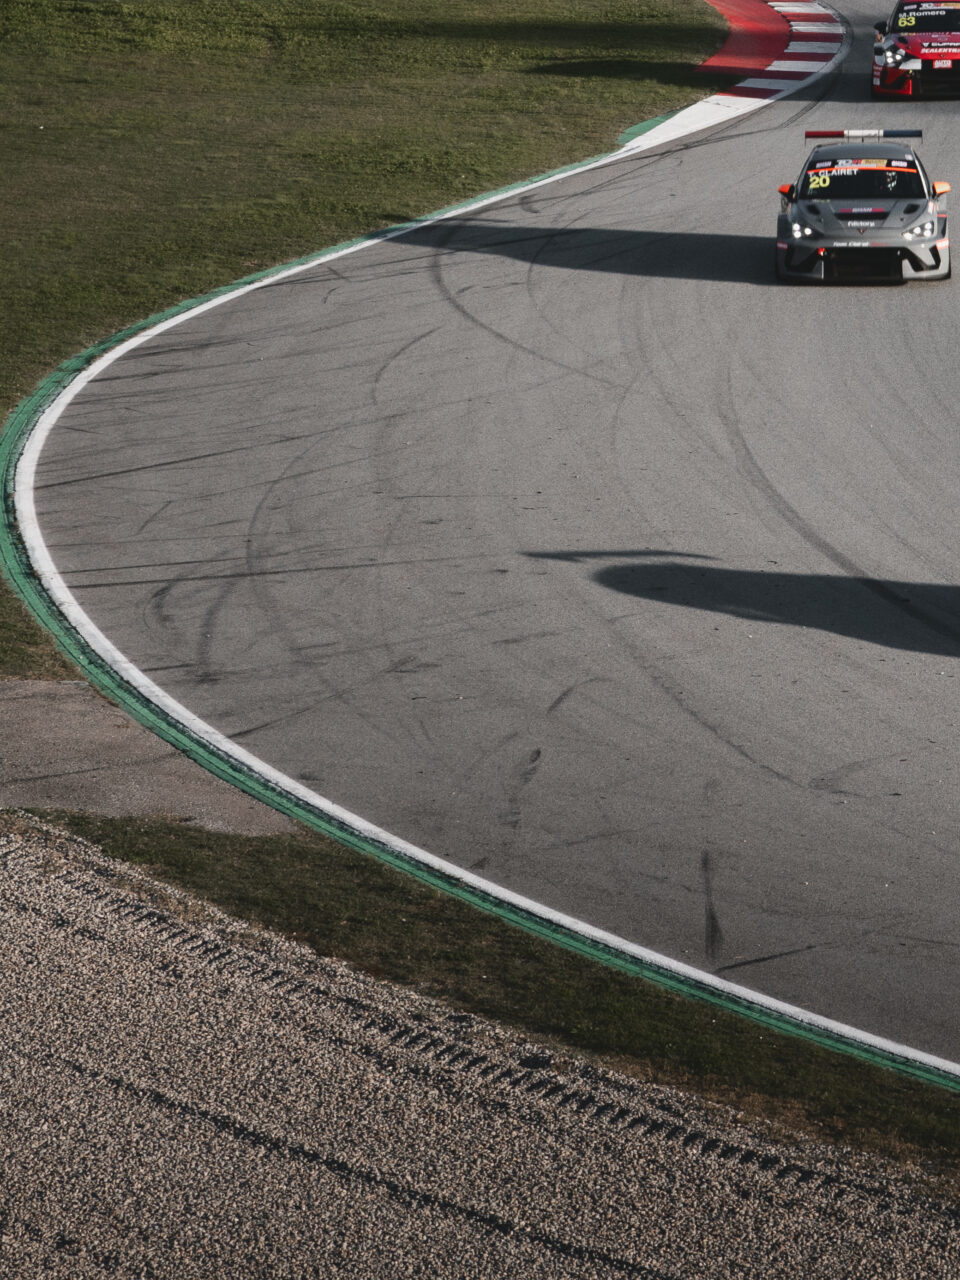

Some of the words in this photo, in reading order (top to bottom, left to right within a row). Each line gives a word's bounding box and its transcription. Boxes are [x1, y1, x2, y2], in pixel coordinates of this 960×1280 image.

[898, 18, 916, 27] 63
[818, 169, 859, 177] CLAIRET
[809, 176, 830, 189] 20
